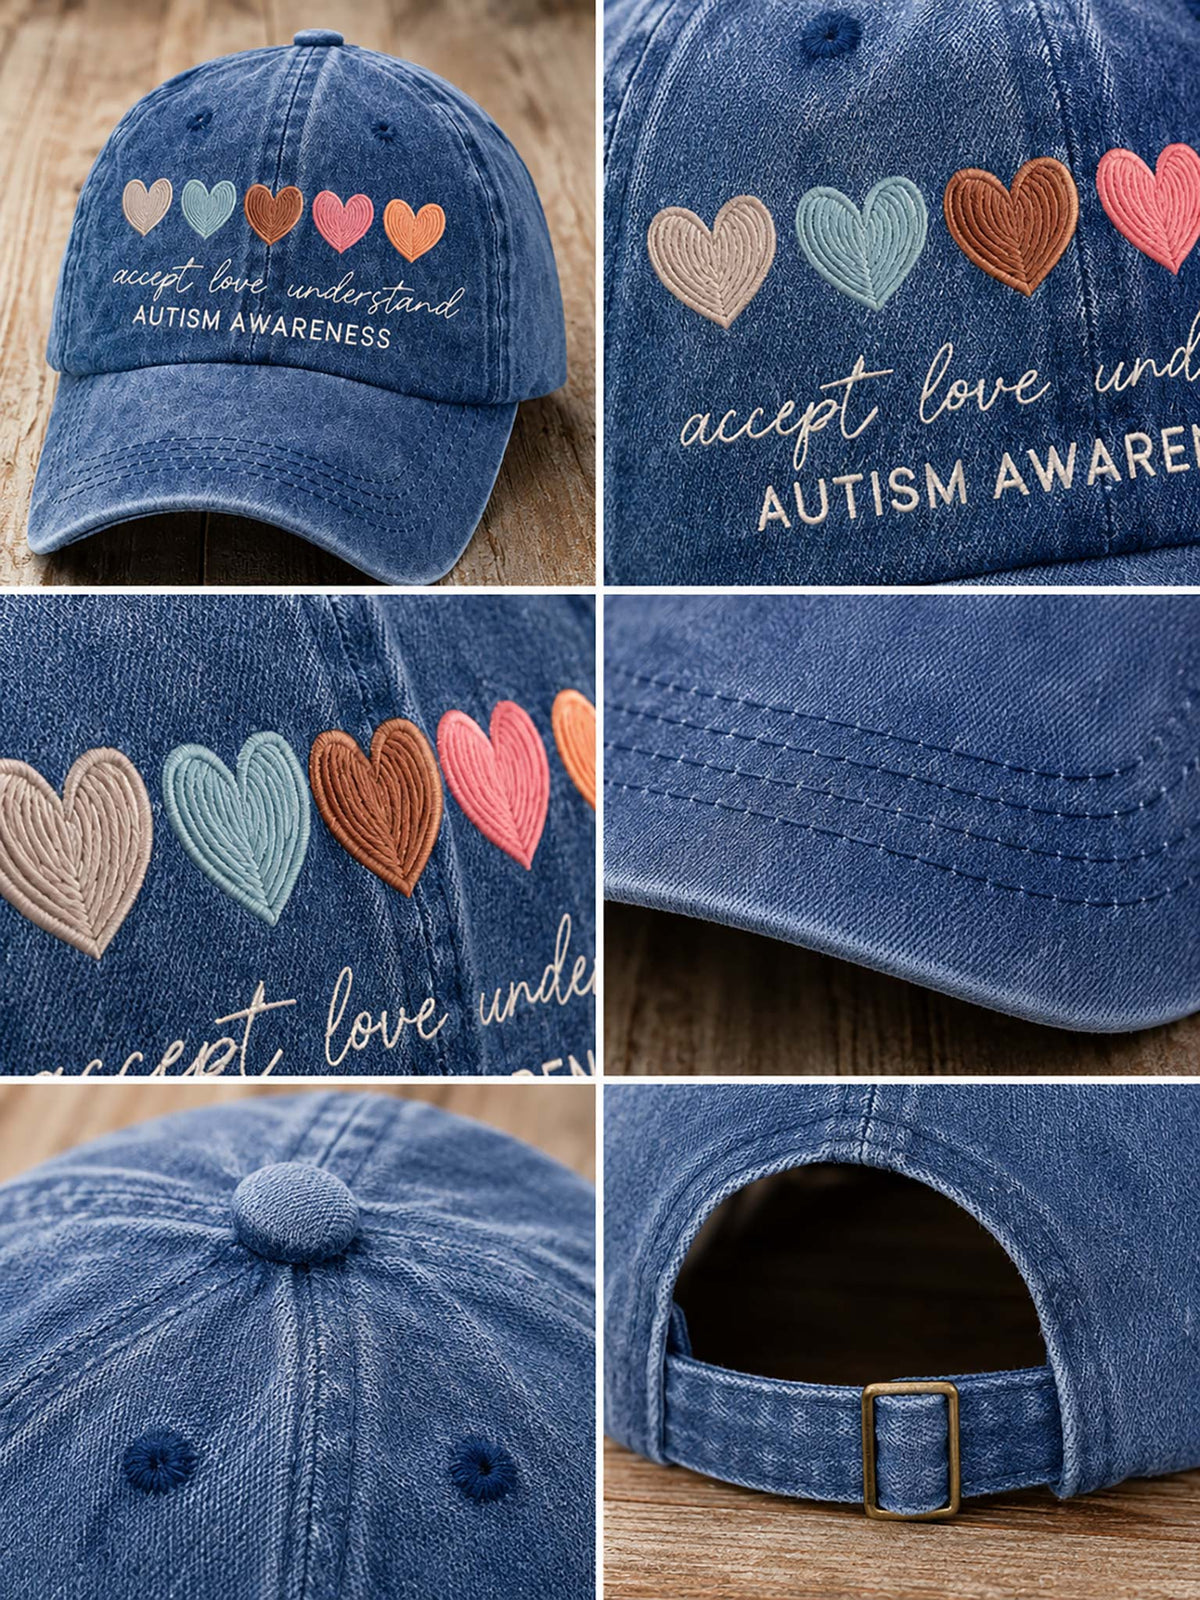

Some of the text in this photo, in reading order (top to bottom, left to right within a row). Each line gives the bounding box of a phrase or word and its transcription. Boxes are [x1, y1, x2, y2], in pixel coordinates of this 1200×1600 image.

[112, 256, 465, 319] accept love understand
[132, 305, 392, 350] AUTISM AWARENESS
[680, 355, 894, 470] accept
[918, 342, 1051, 425] love
[757, 458, 968, 532] AUTISM
[324, 966, 449, 1068] love
[479, 912, 596, 1026] unde
